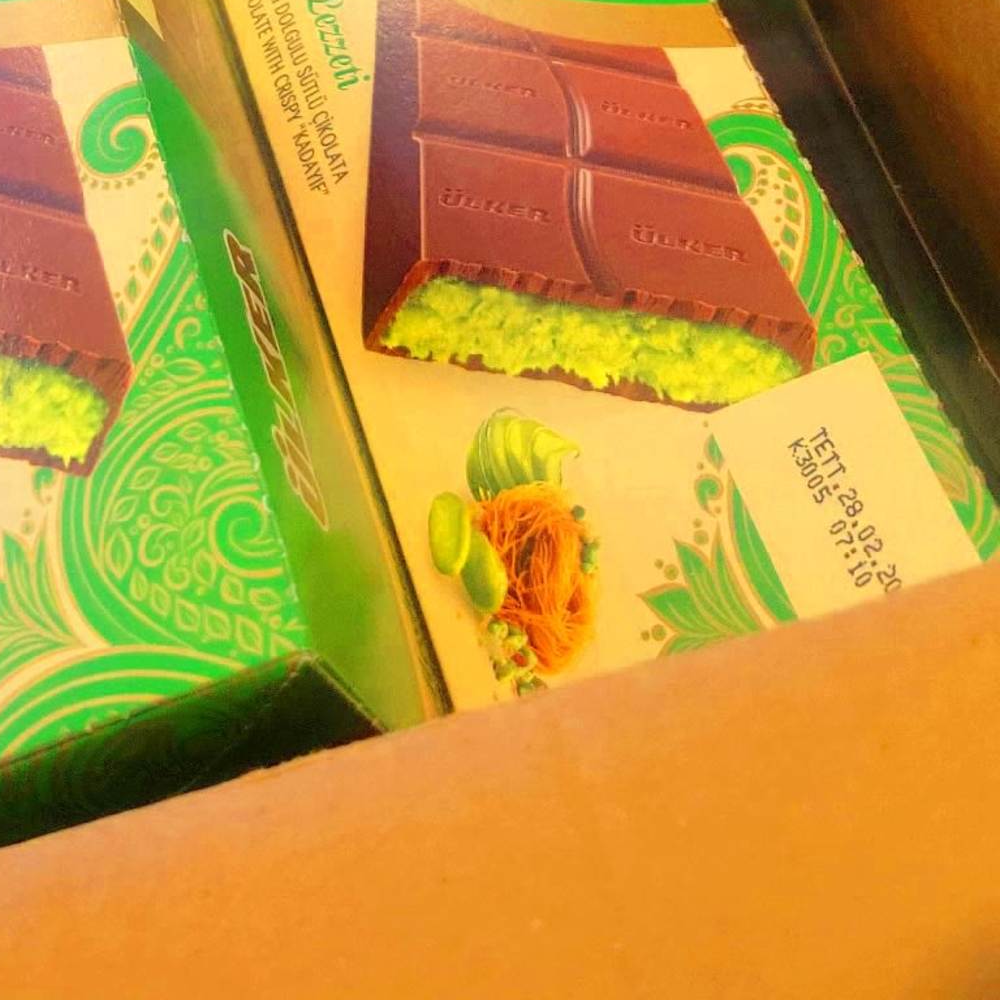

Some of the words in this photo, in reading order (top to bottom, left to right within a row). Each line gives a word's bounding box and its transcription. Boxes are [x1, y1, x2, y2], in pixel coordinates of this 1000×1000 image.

[261, 35, 286, 76] WITH
[274, 1, 309, 67] DOLGULU
[273, 73, 304, 124] CRISPY
[296, 64, 328, 111] SÜTLÜ
[309, 109, 350, 185] ÇİKOLATA
[438, 187, 552, 224] ÜLKER
[630, 222, 751, 265] ÜLKER
[787, 437, 832, 504] K3005
[829, 519, 873, 588] 07:10
